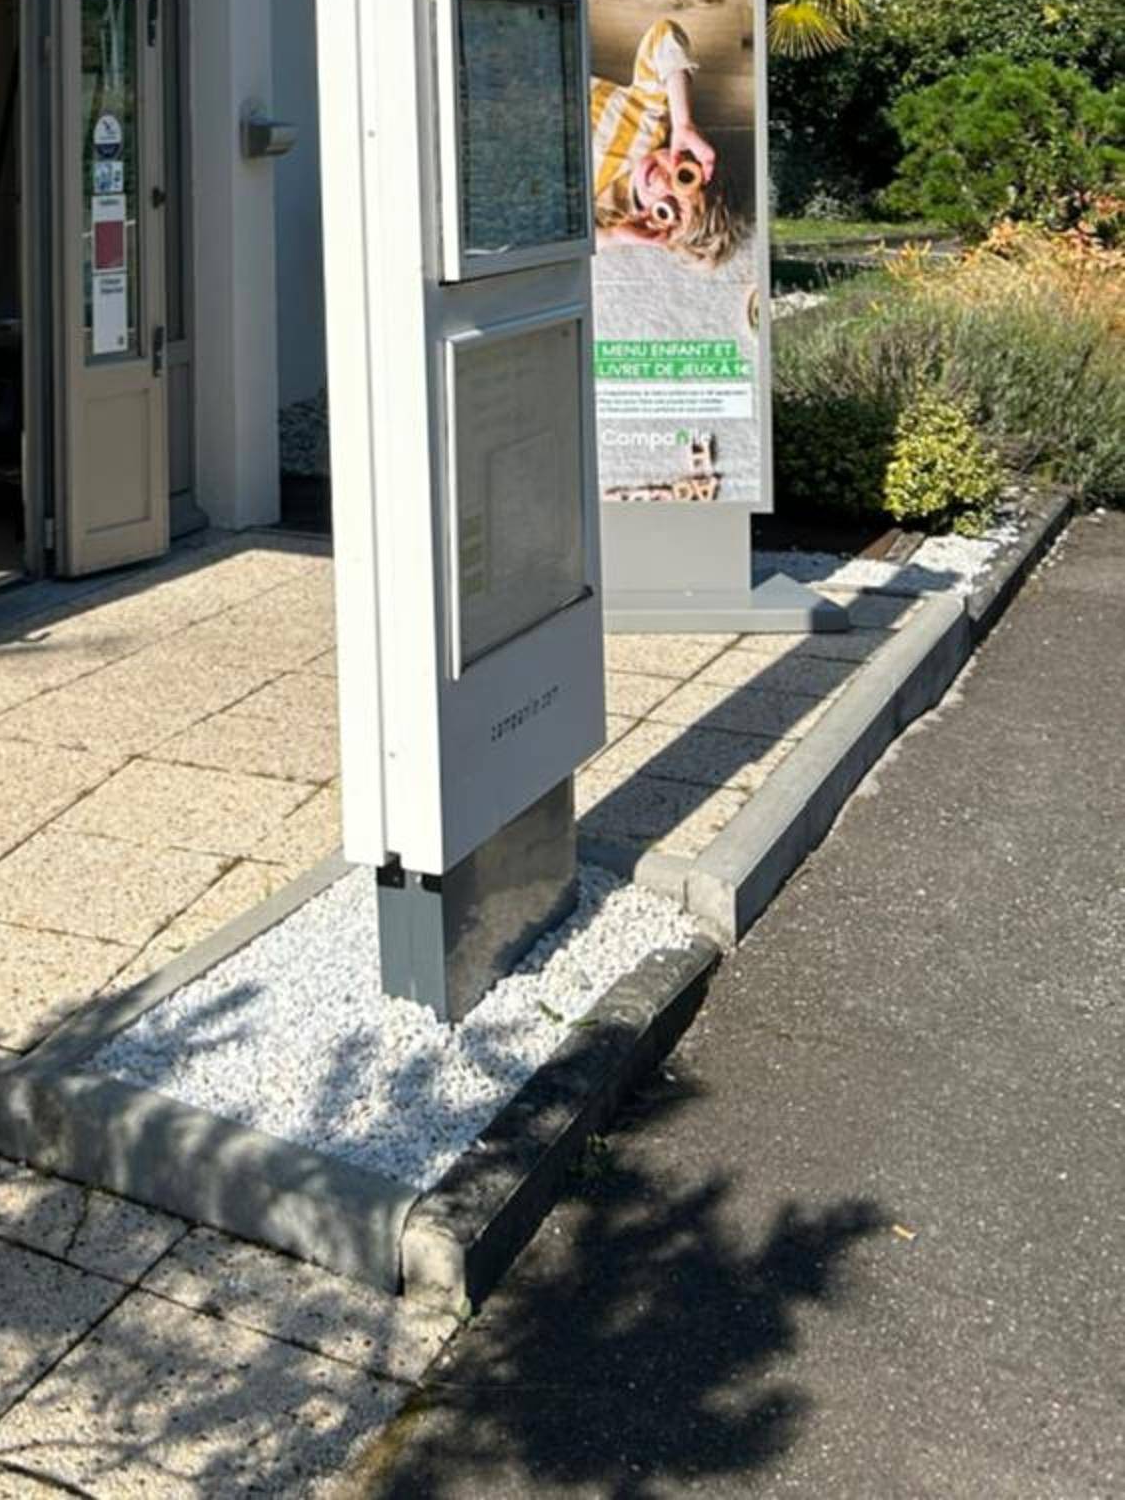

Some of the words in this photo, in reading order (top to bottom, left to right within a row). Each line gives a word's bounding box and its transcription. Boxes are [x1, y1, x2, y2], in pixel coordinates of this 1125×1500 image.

[602, 343, 648, 357] MENU
[651, 343, 709, 357] ENFANT
[716, 343, 734, 357] ET
[599, 362, 652, 376] LIVRET
[655, 362, 674, 376] DE
[678, 362, 716, 376] JEUX
